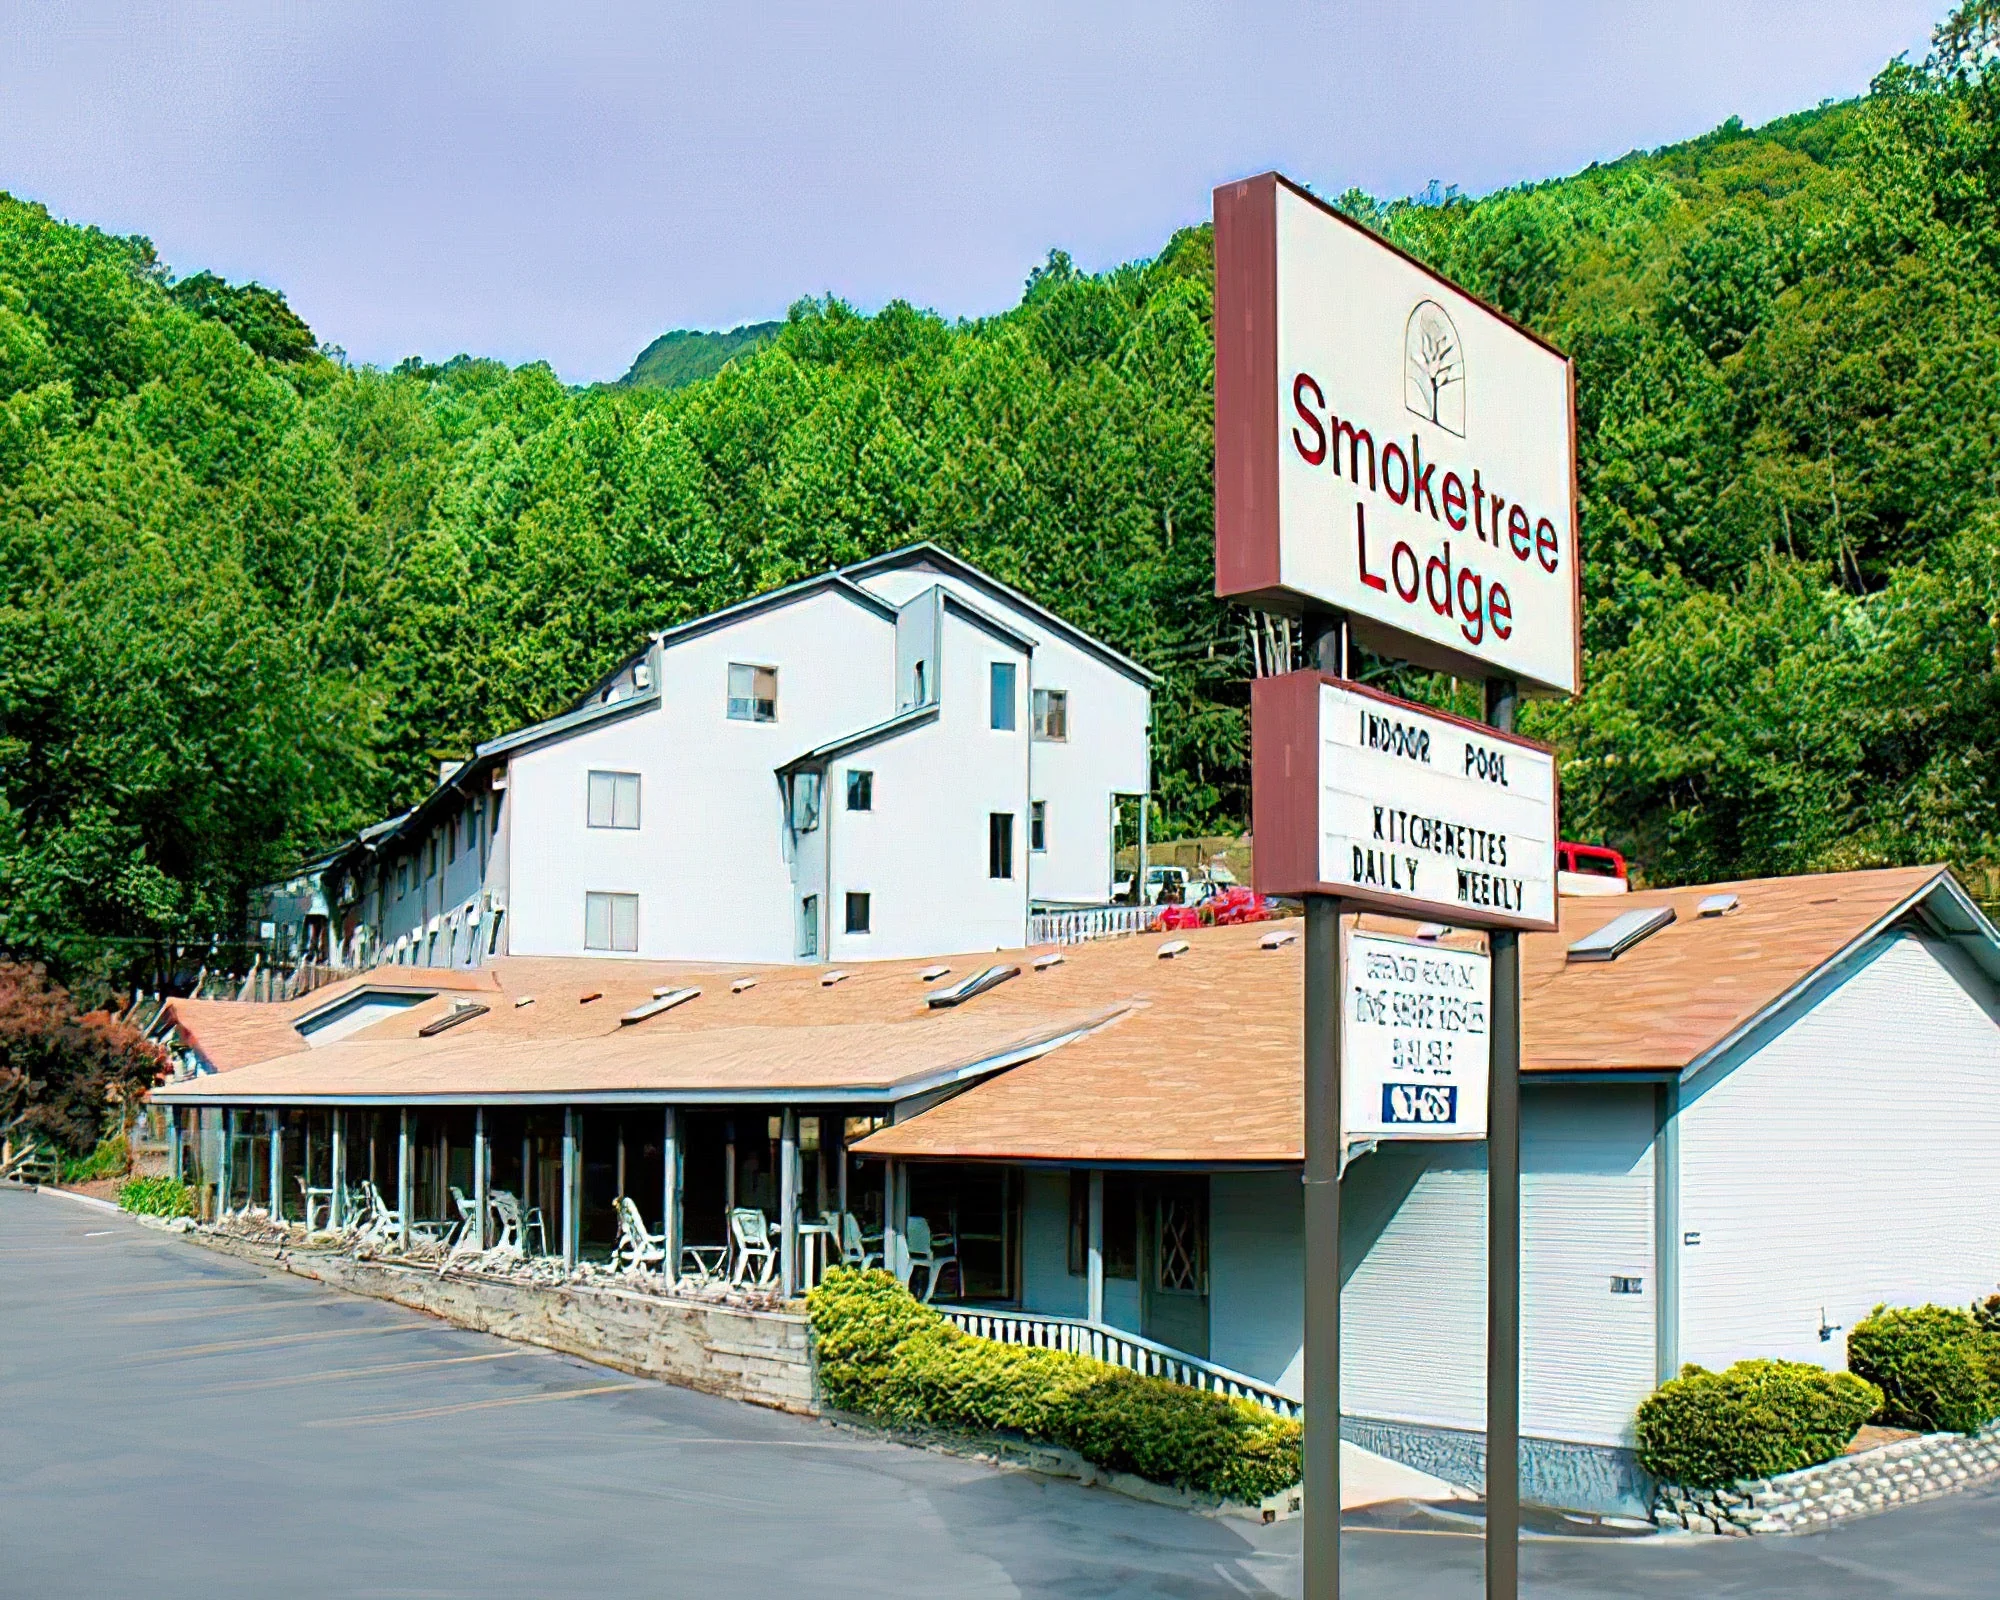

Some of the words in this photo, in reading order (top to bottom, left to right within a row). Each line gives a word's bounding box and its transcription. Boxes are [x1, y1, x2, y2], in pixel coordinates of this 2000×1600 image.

[1292, 372, 1559, 574] Smoketree
[1356, 501, 1513, 646] Lodge
[1360, 710, 1431, 763] INDOOR
[1465, 743, 1508, 786] POOL
[1373, 805, 1507, 868] KITCHENETTES
[1352, 845, 1419, 892] DAILY
[1457, 867, 1522, 911] WEEKLY
